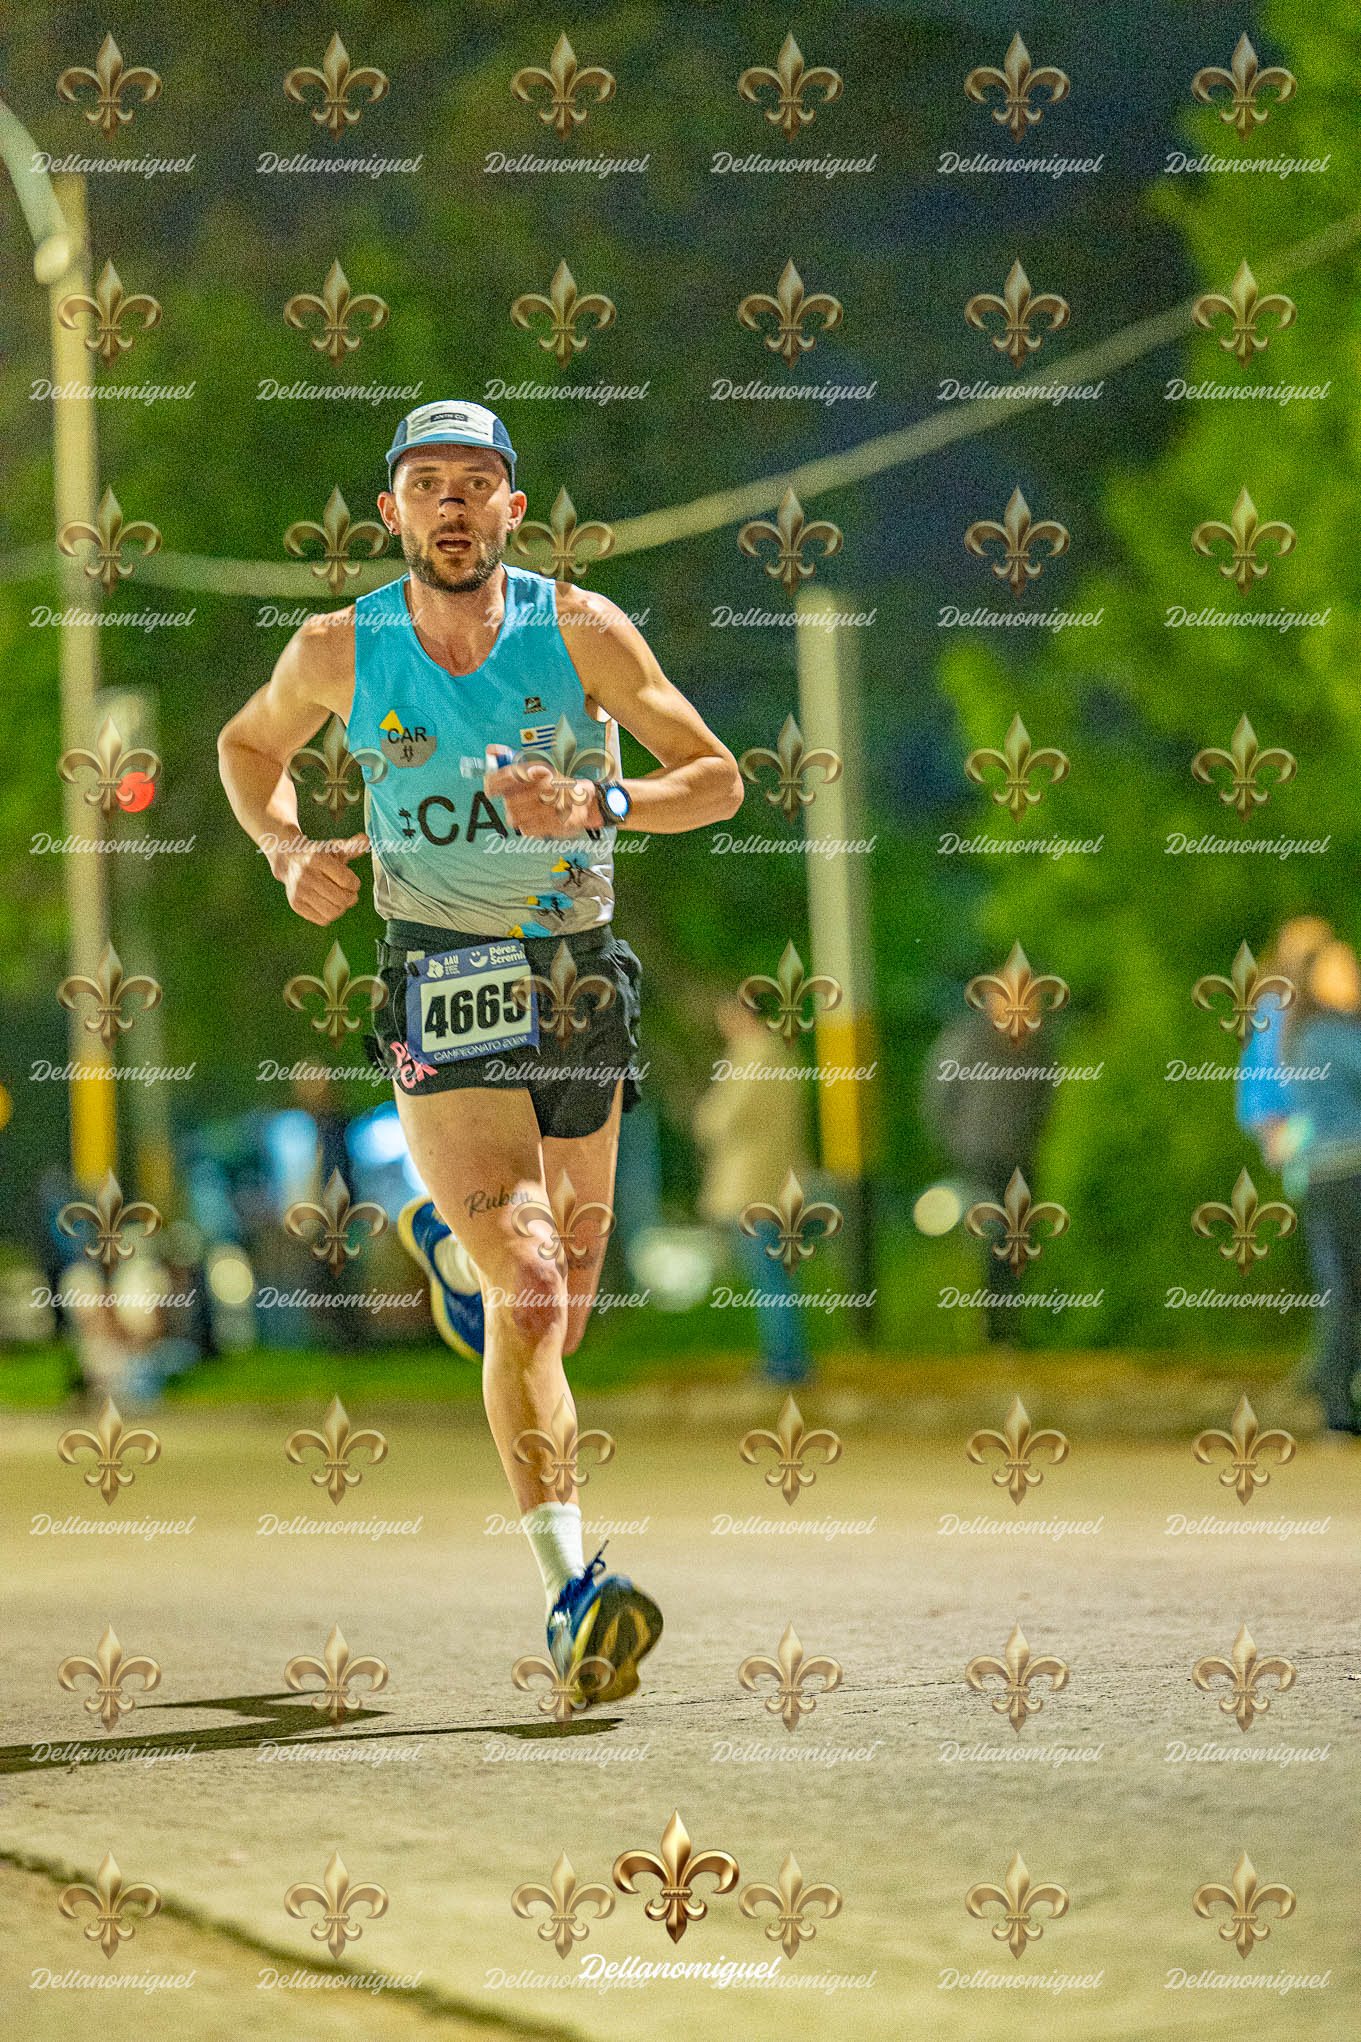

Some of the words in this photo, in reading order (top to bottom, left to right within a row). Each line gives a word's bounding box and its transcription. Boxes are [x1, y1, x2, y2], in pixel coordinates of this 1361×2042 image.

[385, 726, 427, 744] CAR
[444, 954, 459, 967] AAU
[490, 950, 527, 965] Scremi
[424, 981, 526, 1038] 4665
